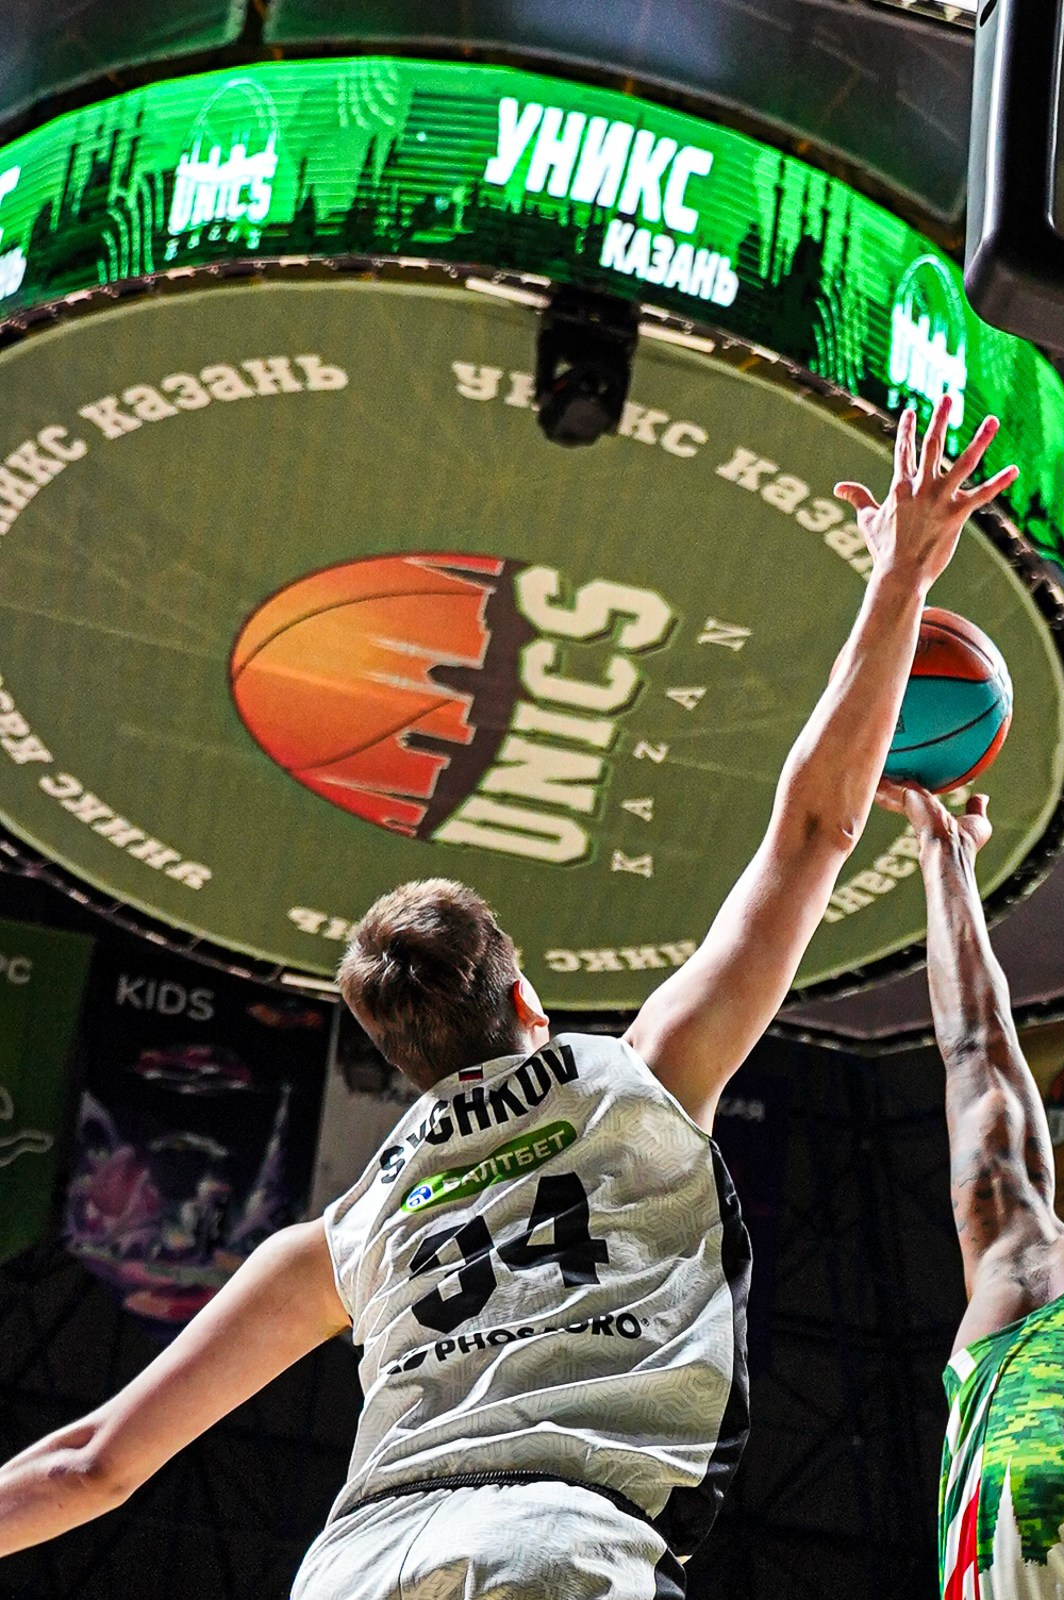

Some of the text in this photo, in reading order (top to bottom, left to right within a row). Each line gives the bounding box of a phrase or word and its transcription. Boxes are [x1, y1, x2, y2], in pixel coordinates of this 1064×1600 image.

[484, 97, 713, 234] УНИКС
[600, 219, 739, 307] КАЗАНЬ
[432, 564, 672, 863] UNICS
[611, 616, 753, 878] KAZAN
[117, 974, 215, 1022] KIDS
